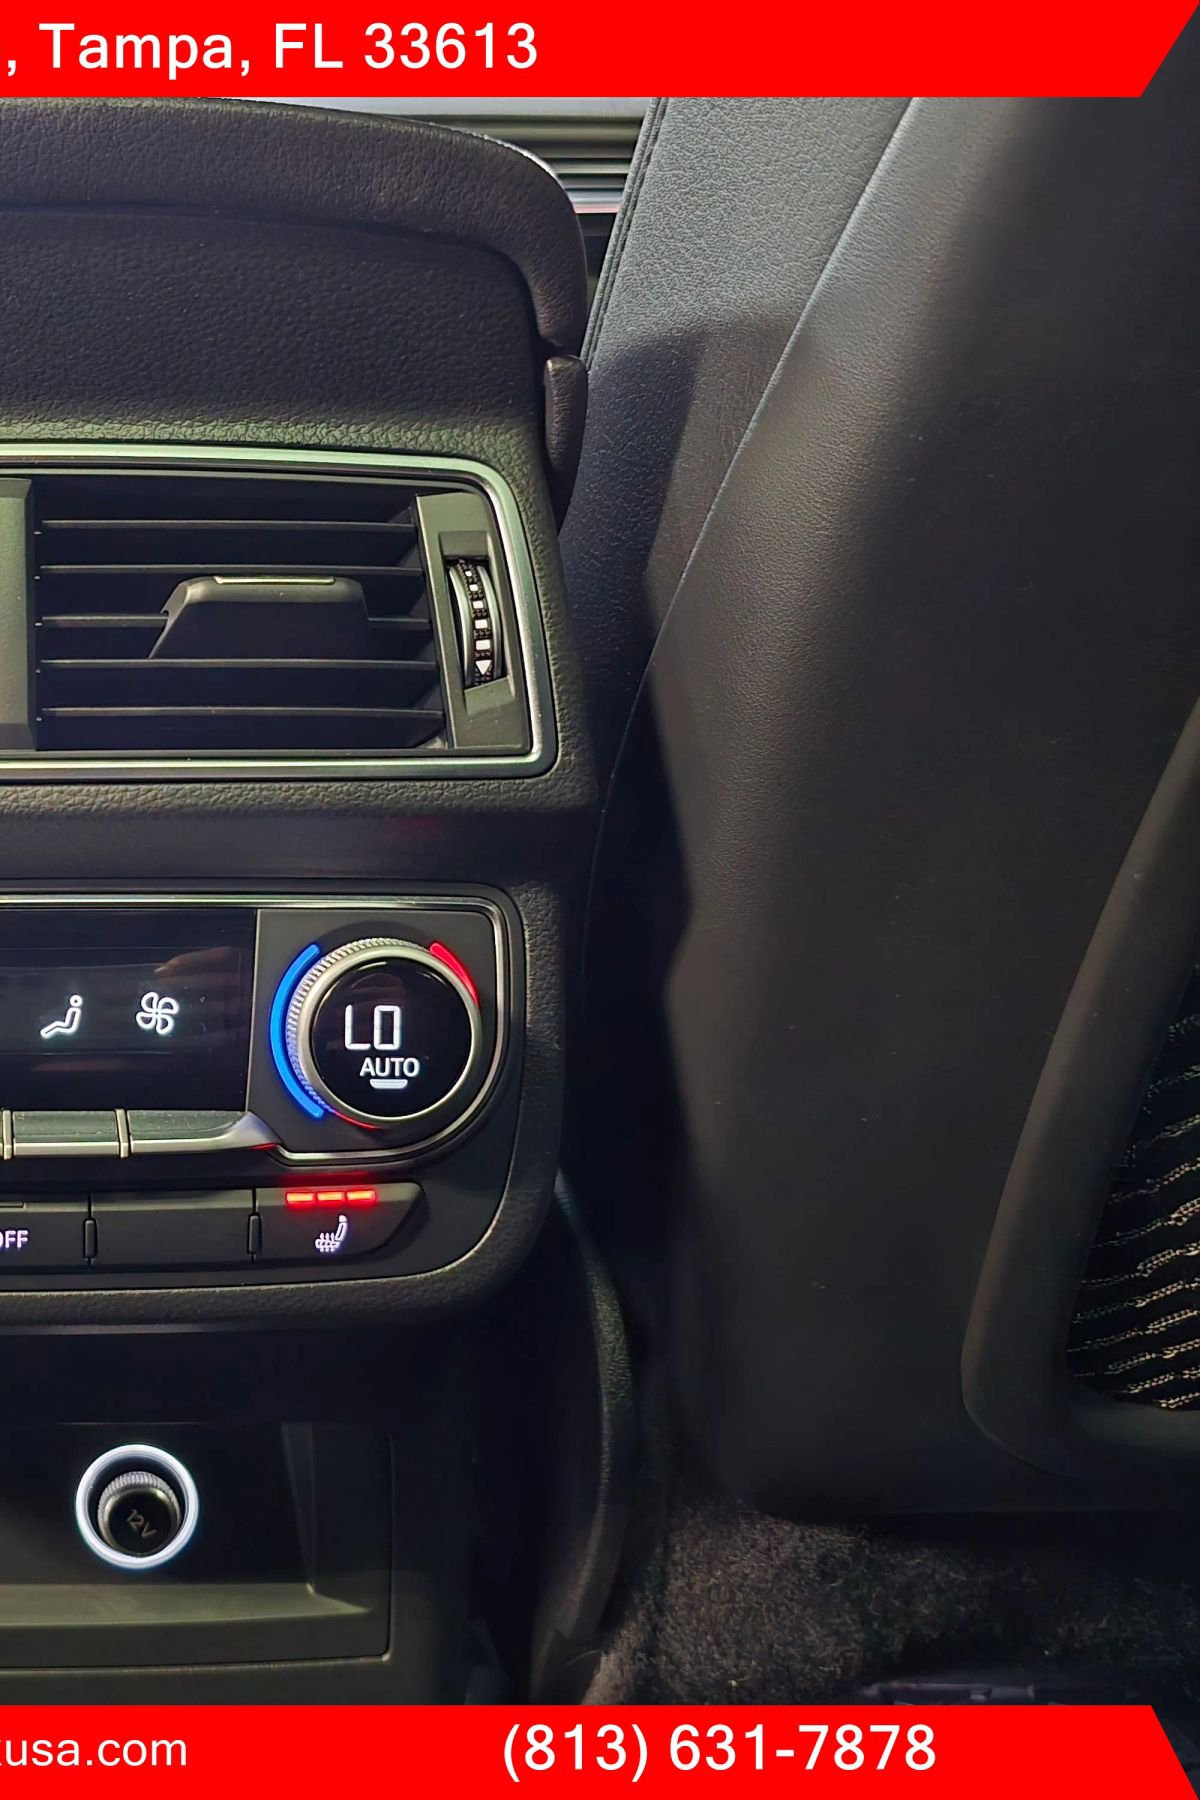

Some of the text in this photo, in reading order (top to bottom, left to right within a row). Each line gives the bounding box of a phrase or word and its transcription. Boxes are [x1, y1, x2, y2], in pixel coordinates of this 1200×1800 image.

[344, 1004, 402, 1050] LO
[359, 1057, 420, 1077] AUTO
[126, 1508, 158, 1538] 12V
